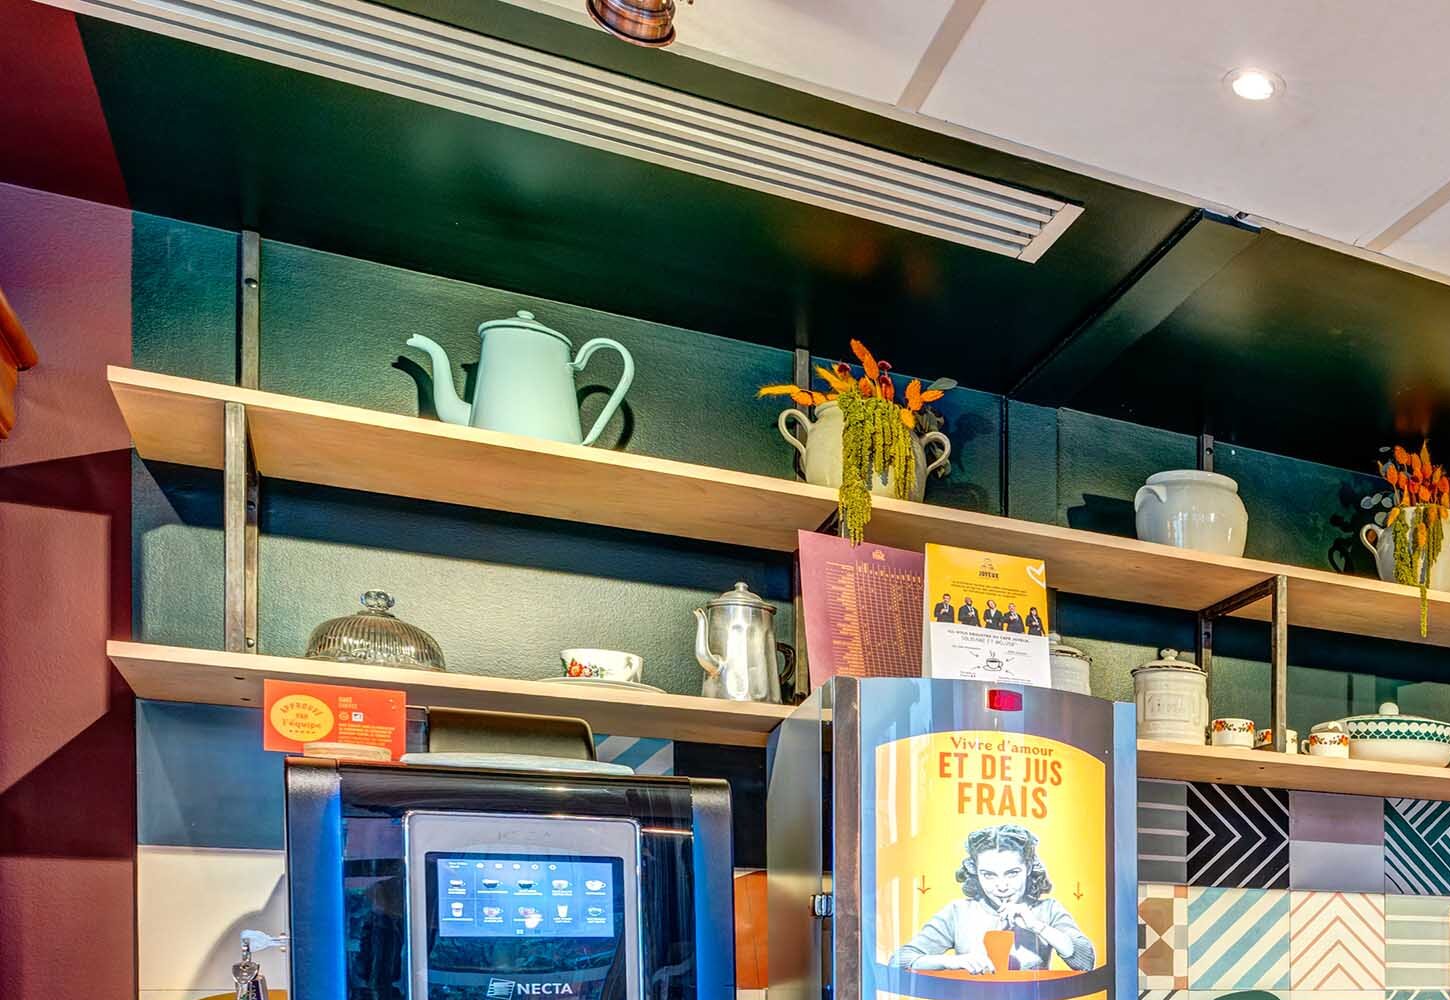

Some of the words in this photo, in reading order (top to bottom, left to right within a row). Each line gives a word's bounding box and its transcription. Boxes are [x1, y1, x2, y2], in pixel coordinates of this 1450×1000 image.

[950, 736, 993, 751] Vivre
[997, 739, 1054, 757] d'amour
[939, 751, 969, 778] ET
[981, 754, 1012, 782] DE
[1023, 757, 1063, 786] JUS
[957, 782, 1048, 820] FRAIS
[516, 982, 574, 996] NECTA
